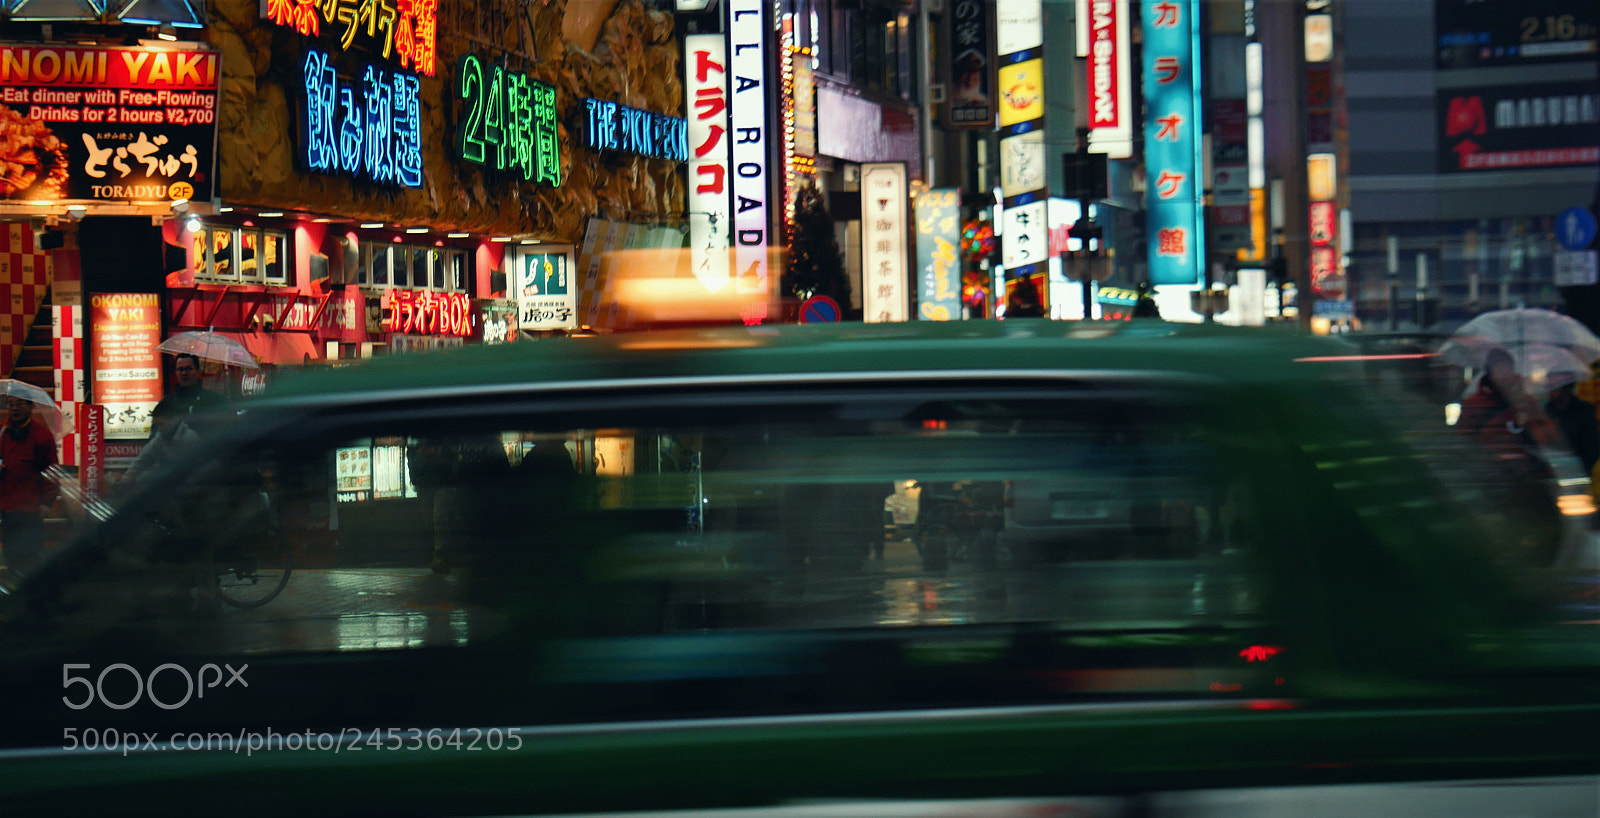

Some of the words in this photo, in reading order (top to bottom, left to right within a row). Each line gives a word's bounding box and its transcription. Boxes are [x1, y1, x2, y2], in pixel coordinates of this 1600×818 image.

[121, 51, 216, 87] YAKI
[30, 106, 79, 121] Drinks
[82, 107, 105, 122] for
[108, 108, 117, 121] 2
[120, 109, 163, 122] hours
[167, 110, 214, 125] ¥2,700
[32, 89, 81, 104] dinner
[84, 90, 116, 104] with
[120, 91, 214, 109] Free-Flowing
[303, 49, 421, 188] 飲み放題
[461, 54, 561, 188] 24時間
[584, 97, 617, 151] THE
[694, 50, 726, 195] トラノコ
[1154, 2, 1187, 258] カラオケ館
[91, 185, 168, 198] TORADYU
[173, 186, 190, 198] 2F
[91, 294, 158, 308] OKONOMI
[108, 308, 144, 322] YAKI
[389, 288, 473, 338] カラオケBOX
